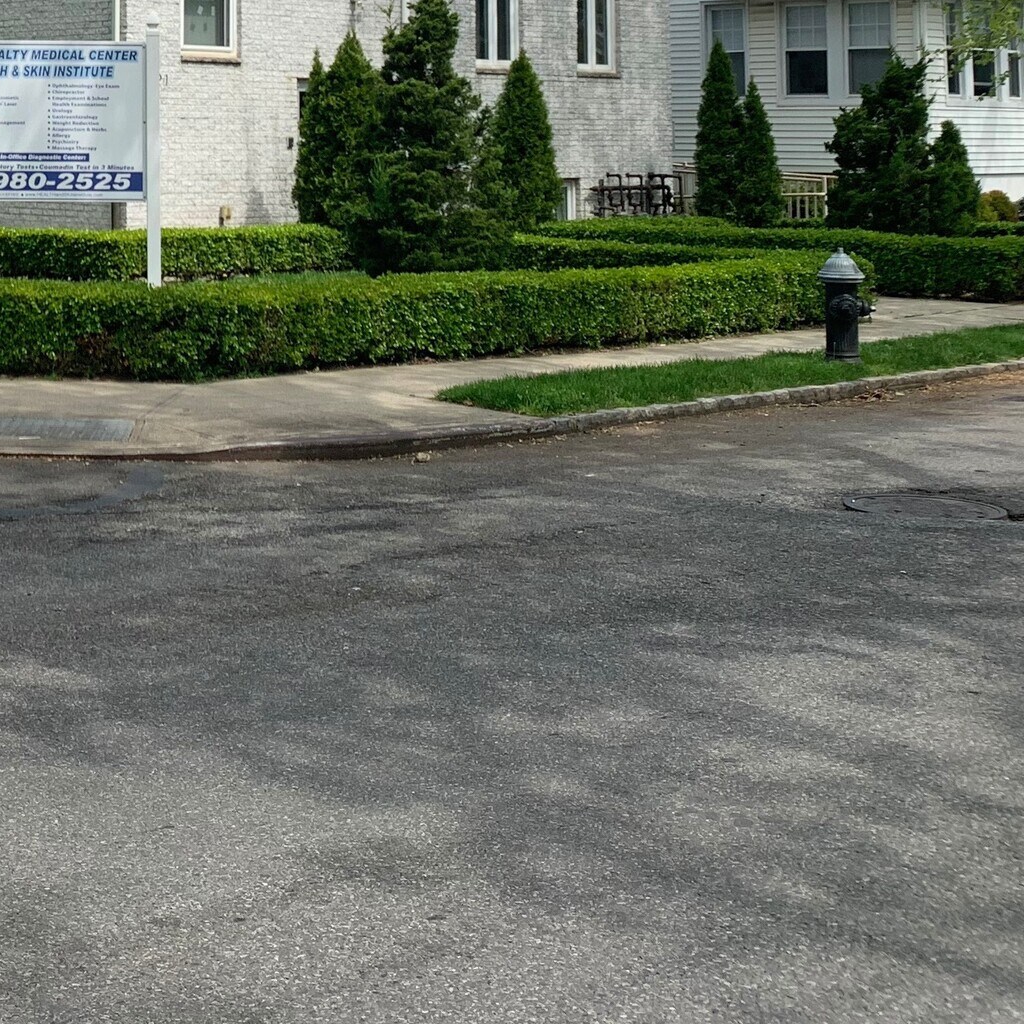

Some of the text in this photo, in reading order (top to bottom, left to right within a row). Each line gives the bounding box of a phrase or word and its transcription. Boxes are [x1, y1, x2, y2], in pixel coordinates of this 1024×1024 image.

[31, 49, 85, 61] MEDICAL
[89, 50, 138, 61] CENTER
[12, 65, 20, 77] &
[23, 65, 51, 77] SKIN
[54, 65, 114, 77] INSTITUTE
